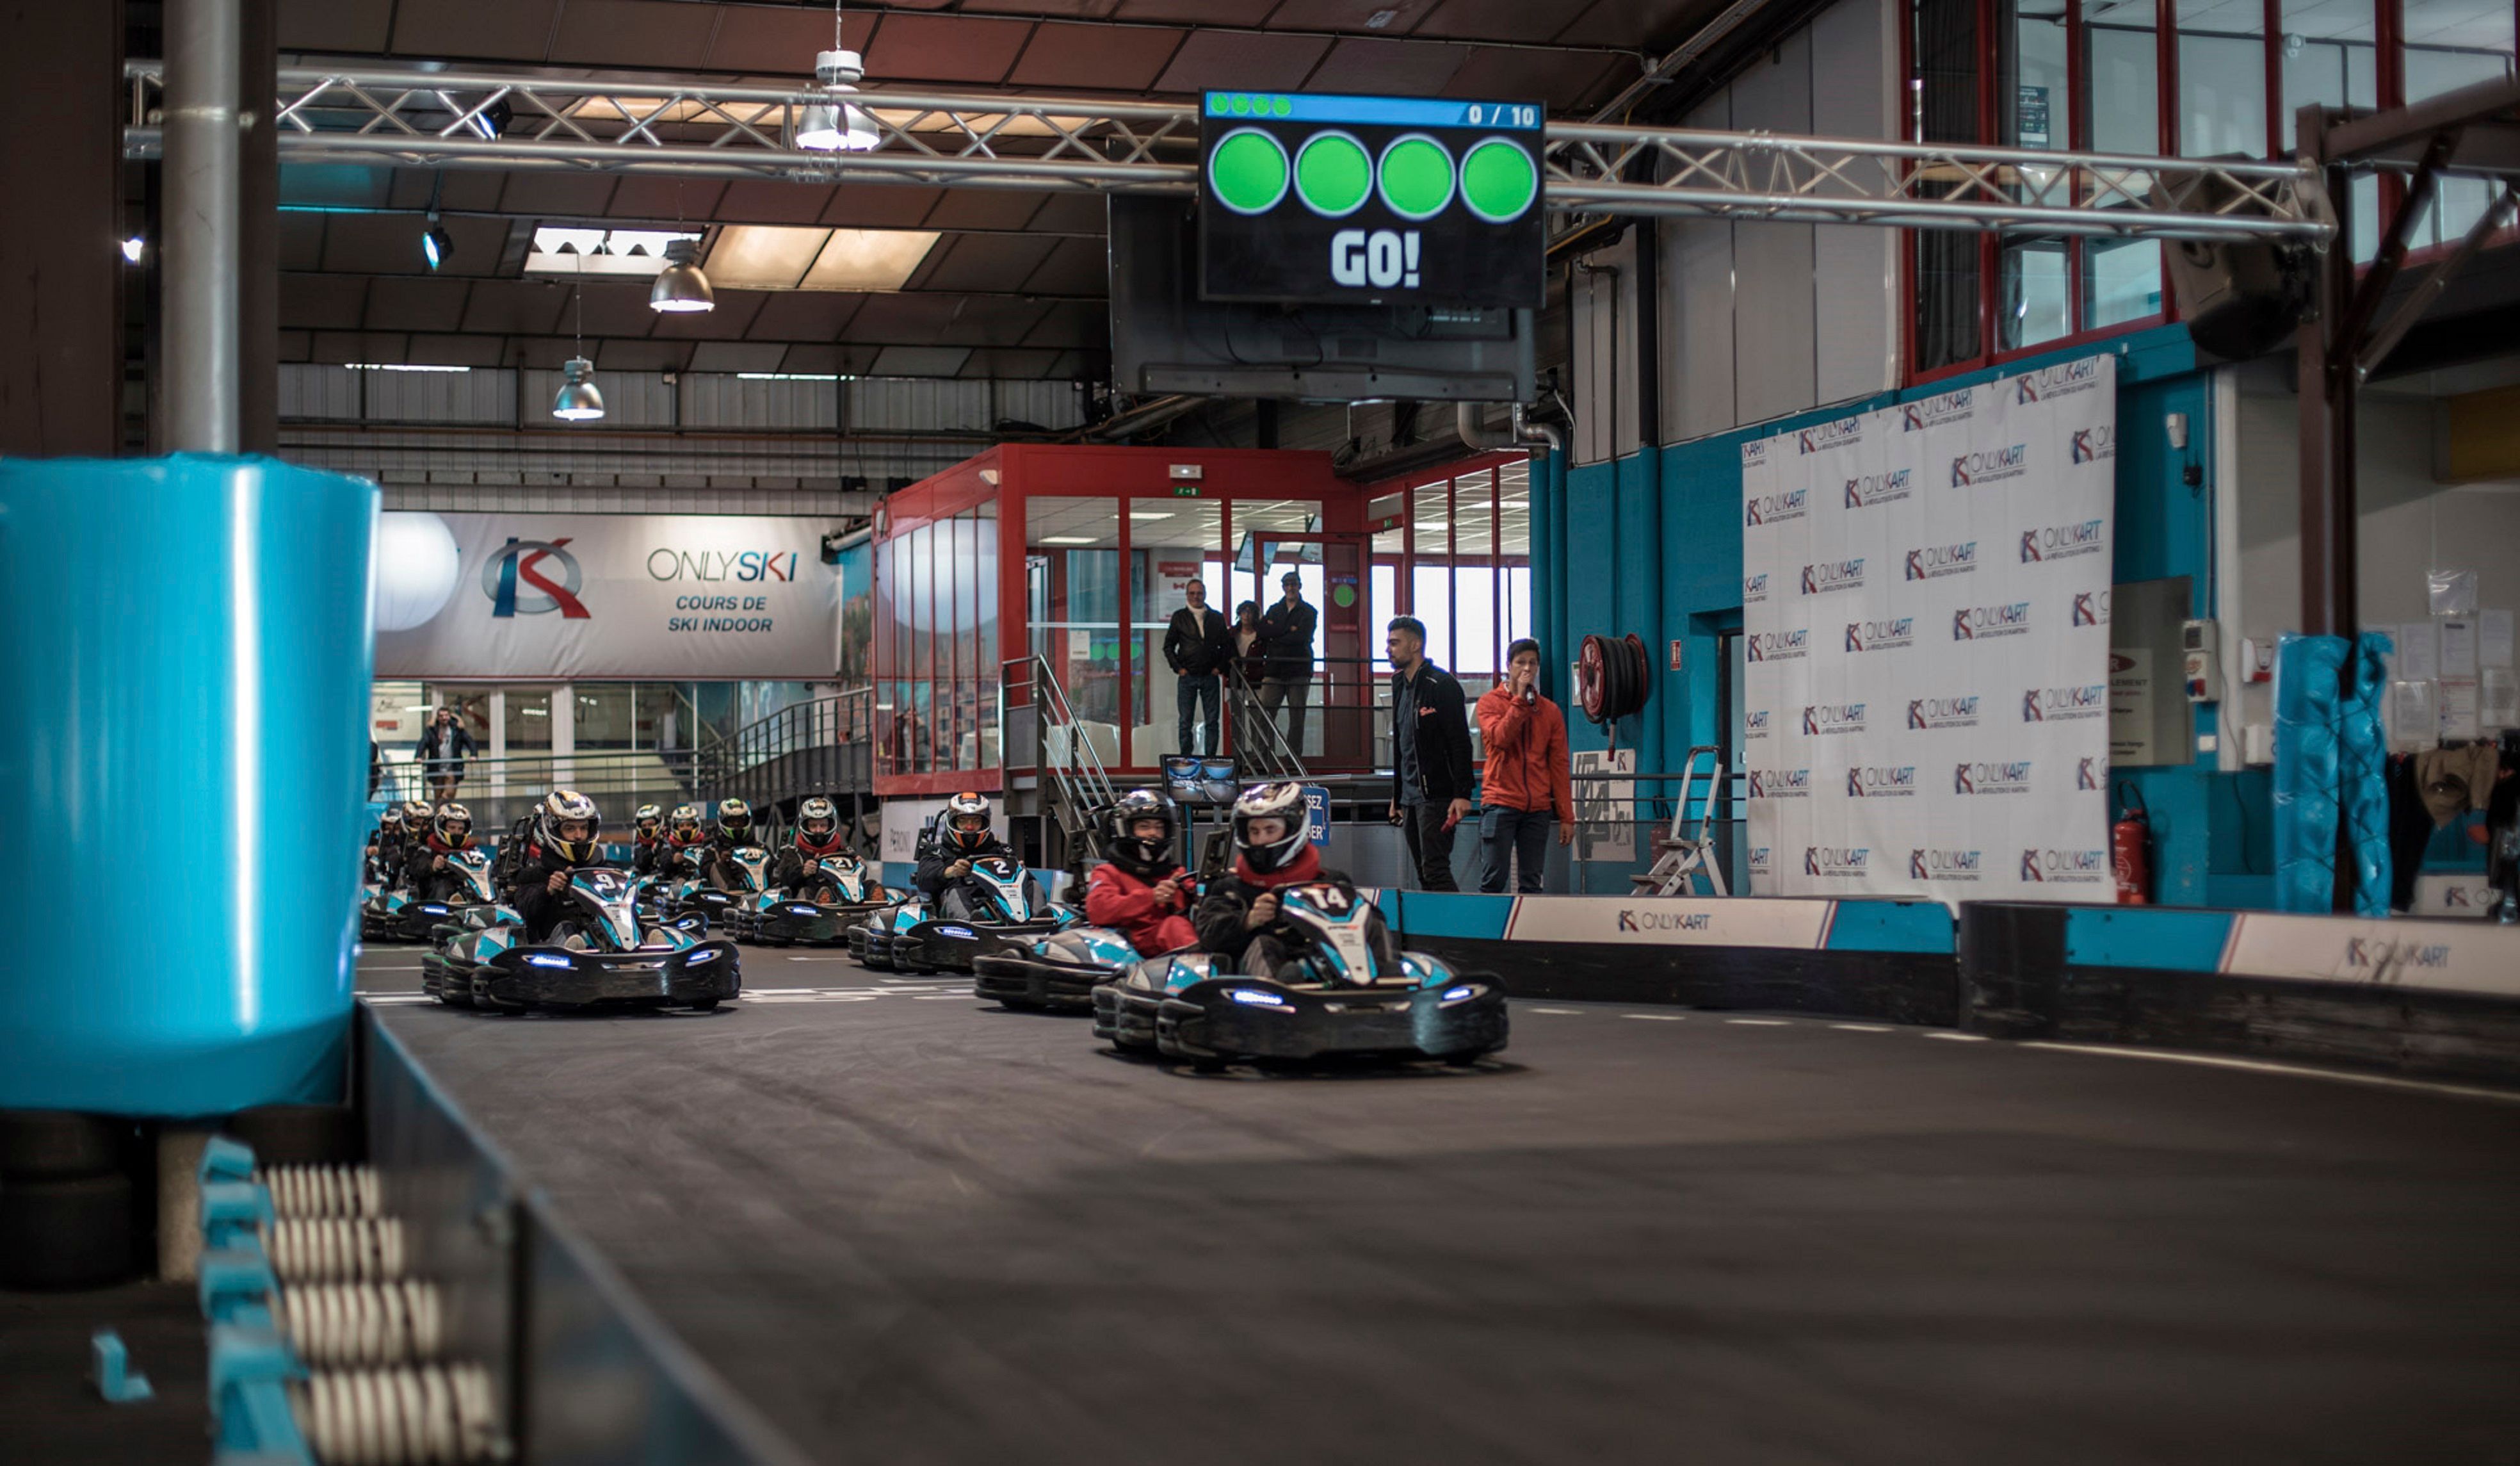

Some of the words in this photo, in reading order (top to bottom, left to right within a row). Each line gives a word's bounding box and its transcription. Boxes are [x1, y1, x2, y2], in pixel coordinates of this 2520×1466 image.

[1469, 105, 1482, 124] 0
[1491, 106, 1501, 124] /
[1512, 106, 1534, 126] 10
[1331, 230, 1420, 288] GO!
[1971, 444, 2026, 473] ONLYKART
[1862, 469, 1911, 494] ONLYKART
[1764, 489, 1807, 514] ONLYKART
[2044, 519, 2103, 548] ONLYKART
[1926, 542, 1977, 566] ONLYKART
[647, 548, 798, 582] ONLYSKI
[1820, 558, 1864, 582] ONLYKART
[1745, 574, 1768, 592] KART
[676, 596, 738, 610] COURS
[743, 596, 766, 610] DE
[668, 617, 698, 631] SKI
[703, 617, 773, 632] INDOOR
[1974, 602, 2030, 628] ONLYKART
[1865, 618, 1914, 640] ONLYKART
[1765, 630, 1808, 650] ONLYKART
[1928, 696, 1979, 718] ONLYKART
[2046, 685, 2105, 709] ONLYKART
[1746, 711, 1769, 728] KART
[1821, 704, 1866, 723] ONLYKART
[1766, 770, 1809, 788] ONLYKART
[1866, 767, 1916, 786] ONLYKART
[1976, 762, 2031, 783] ONLYKART
[834, 857, 853, 869] 21
[1822, 847, 1870, 865] ONLYKART
[1931, 849, 1981, 869] ONLYKART
[2046, 849, 2104, 870] ONLYKART
[993, 861, 1010, 874] 2
[595, 873, 615, 890] 9
[1301, 887, 1348, 909] 14
[1642, 912, 1711, 930] ONLYKART
